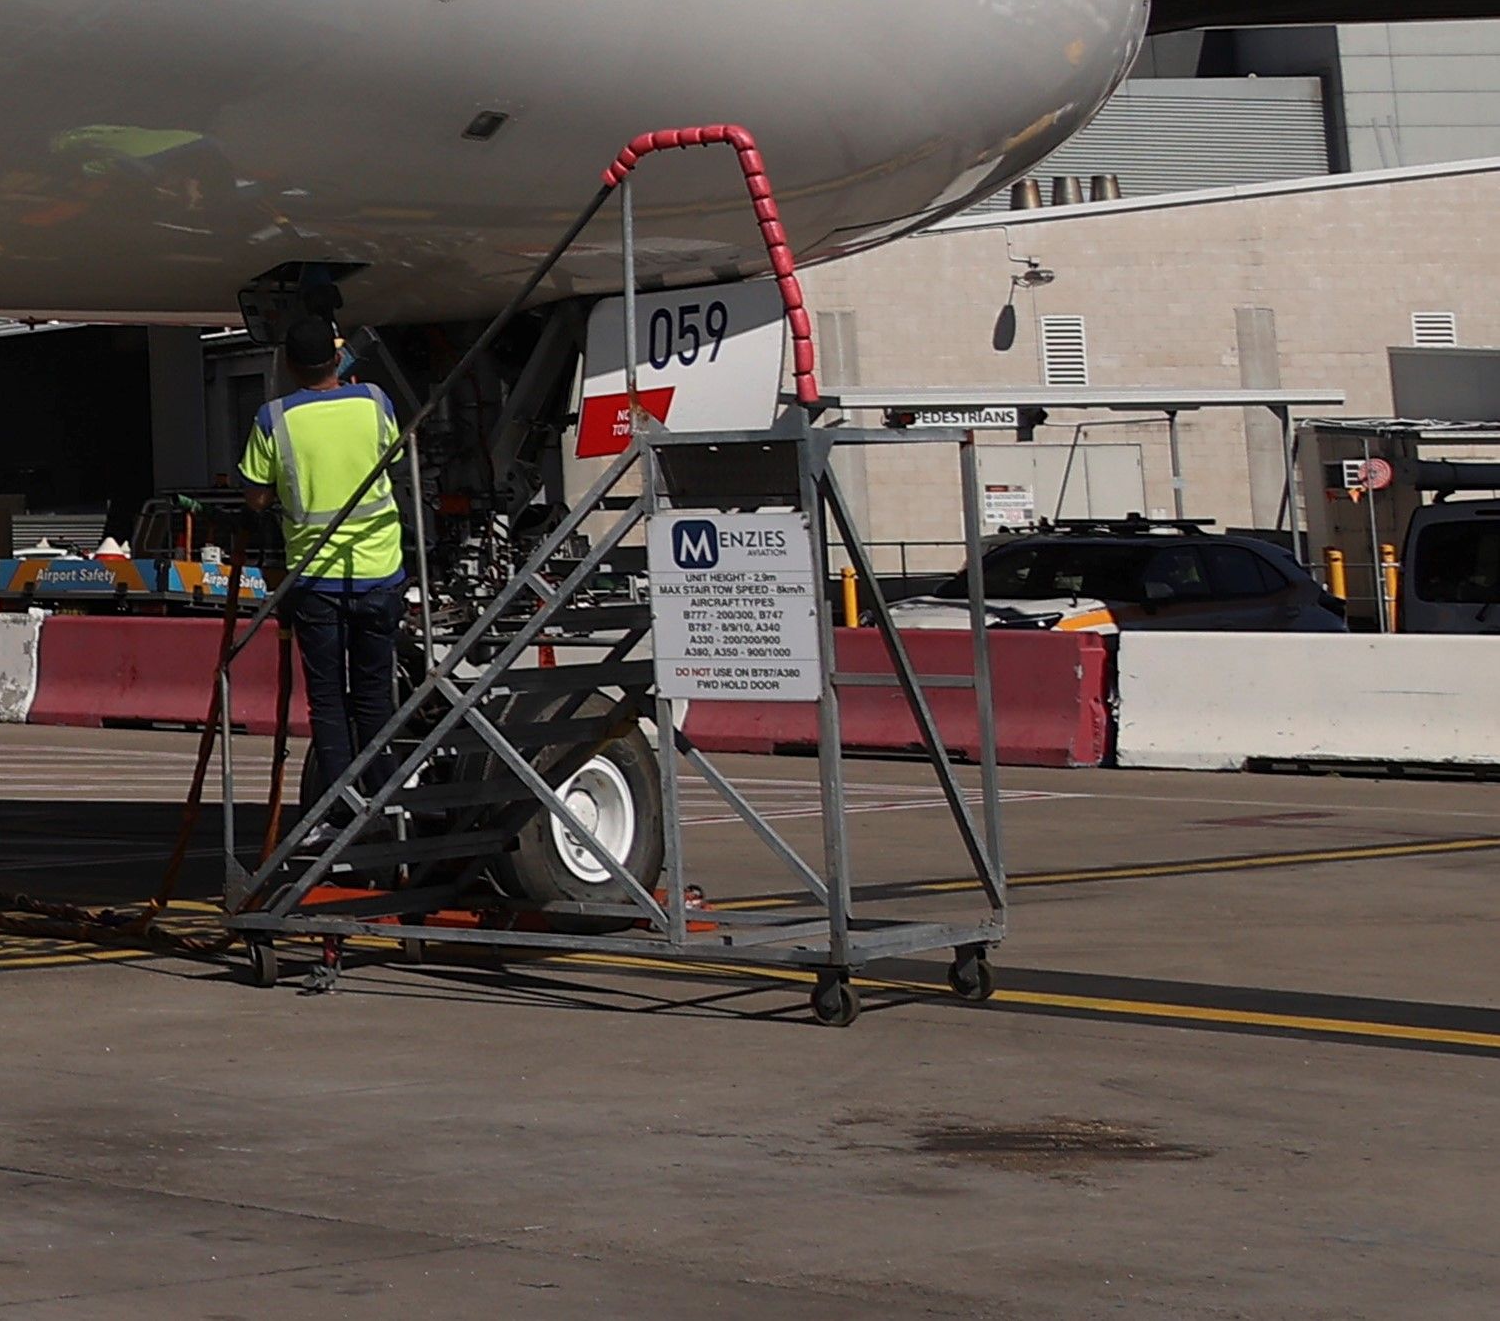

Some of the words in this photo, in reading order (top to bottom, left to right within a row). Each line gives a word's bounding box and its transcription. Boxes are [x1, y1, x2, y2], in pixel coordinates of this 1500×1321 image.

[649, 301, 727, 370] 059
[676, 526, 786, 565] MENZIES
[747, 549, 787, 557] AVIATION
[36, 568, 76, 583] Airport
[79, 568, 116, 583] Safety
[685, 574, 707, 582] UNIT
[710, 574, 745, 582] HEIGHT
[754, 574, 776, 582] 2.9m
[202, 572, 229, 588] Airpo
[736, 586, 768, 594] SPEED
[691, 598, 740, 606] AIRCRAFT
[742, 598, 774, 606] TYPES
[683, 611, 707, 619] B777
[717, 611, 757, 620] 200/300,
[759, 611, 783, 619] B747
[756, 623, 780, 631] A340
[690, 636, 714, 644] A330
[723, 636, 780, 644] 200/300/900
[685, 649, 711, 657] A380,
[747, 648, 790, 656] 900/1000
[676, 668, 690, 676] DO
[692, 668, 711, 676] NOT
[713, 669, 732, 677] USE
[735, 669, 749, 677] ON
[697, 681, 717, 689] FWD
[721, 681, 747, 689] HOLD
[750, 681, 779, 689] DOOR
